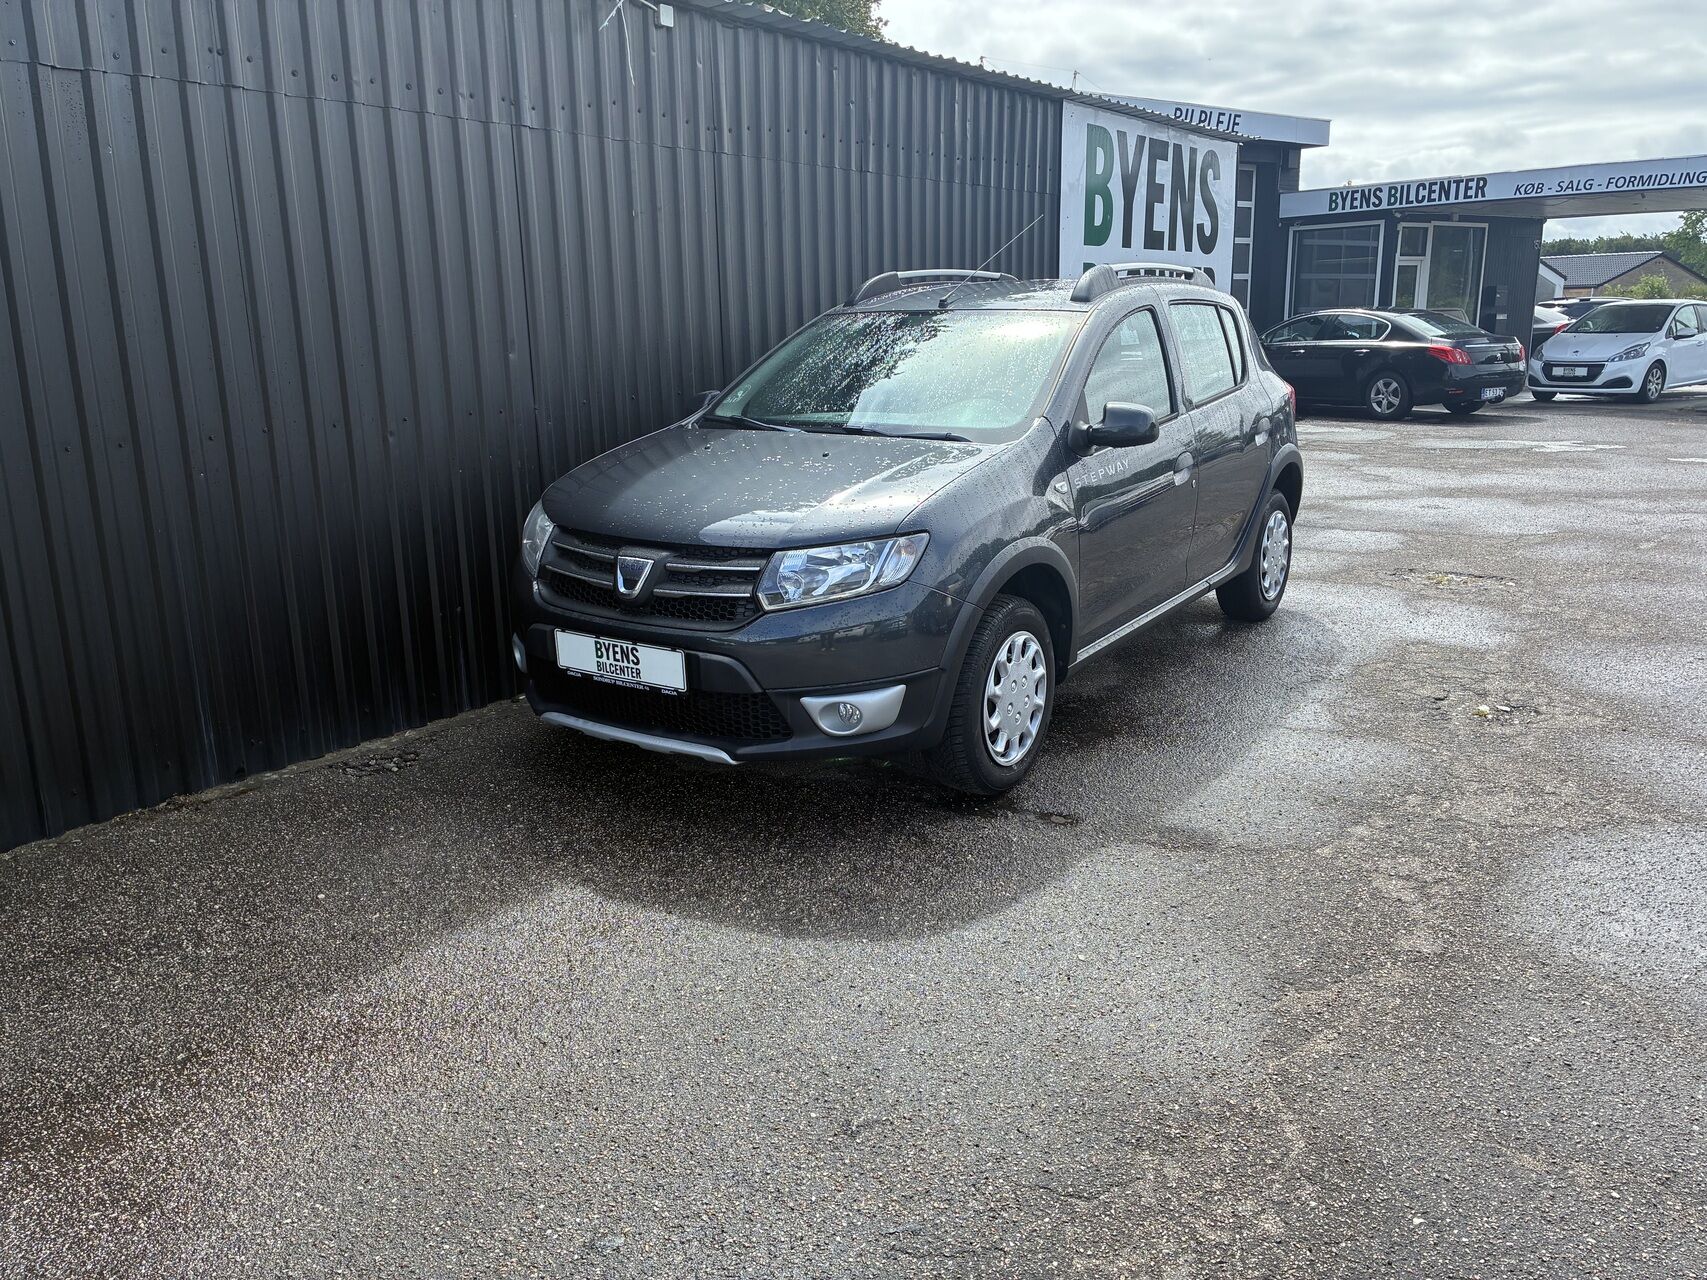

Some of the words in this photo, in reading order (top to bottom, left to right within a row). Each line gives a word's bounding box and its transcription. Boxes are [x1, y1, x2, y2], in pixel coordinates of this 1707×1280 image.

[1083, 122, 1221, 255] BYENS
[1328, 187, 1384, 212] BYENS
[1386, 176, 1488, 207] BILCENTER
[1513, 182, 1545, 196] KØB
[1555, 178, 1595, 193] SALG
[1605, 171, 1707, 190] FORMIDLING
[1074, 460, 1130, 489] STEPWAY
[594, 640, 641, 666] BYENS
[596, 661, 642, 680] BILCENTER
[661, 688, 678, 696] DACIA
